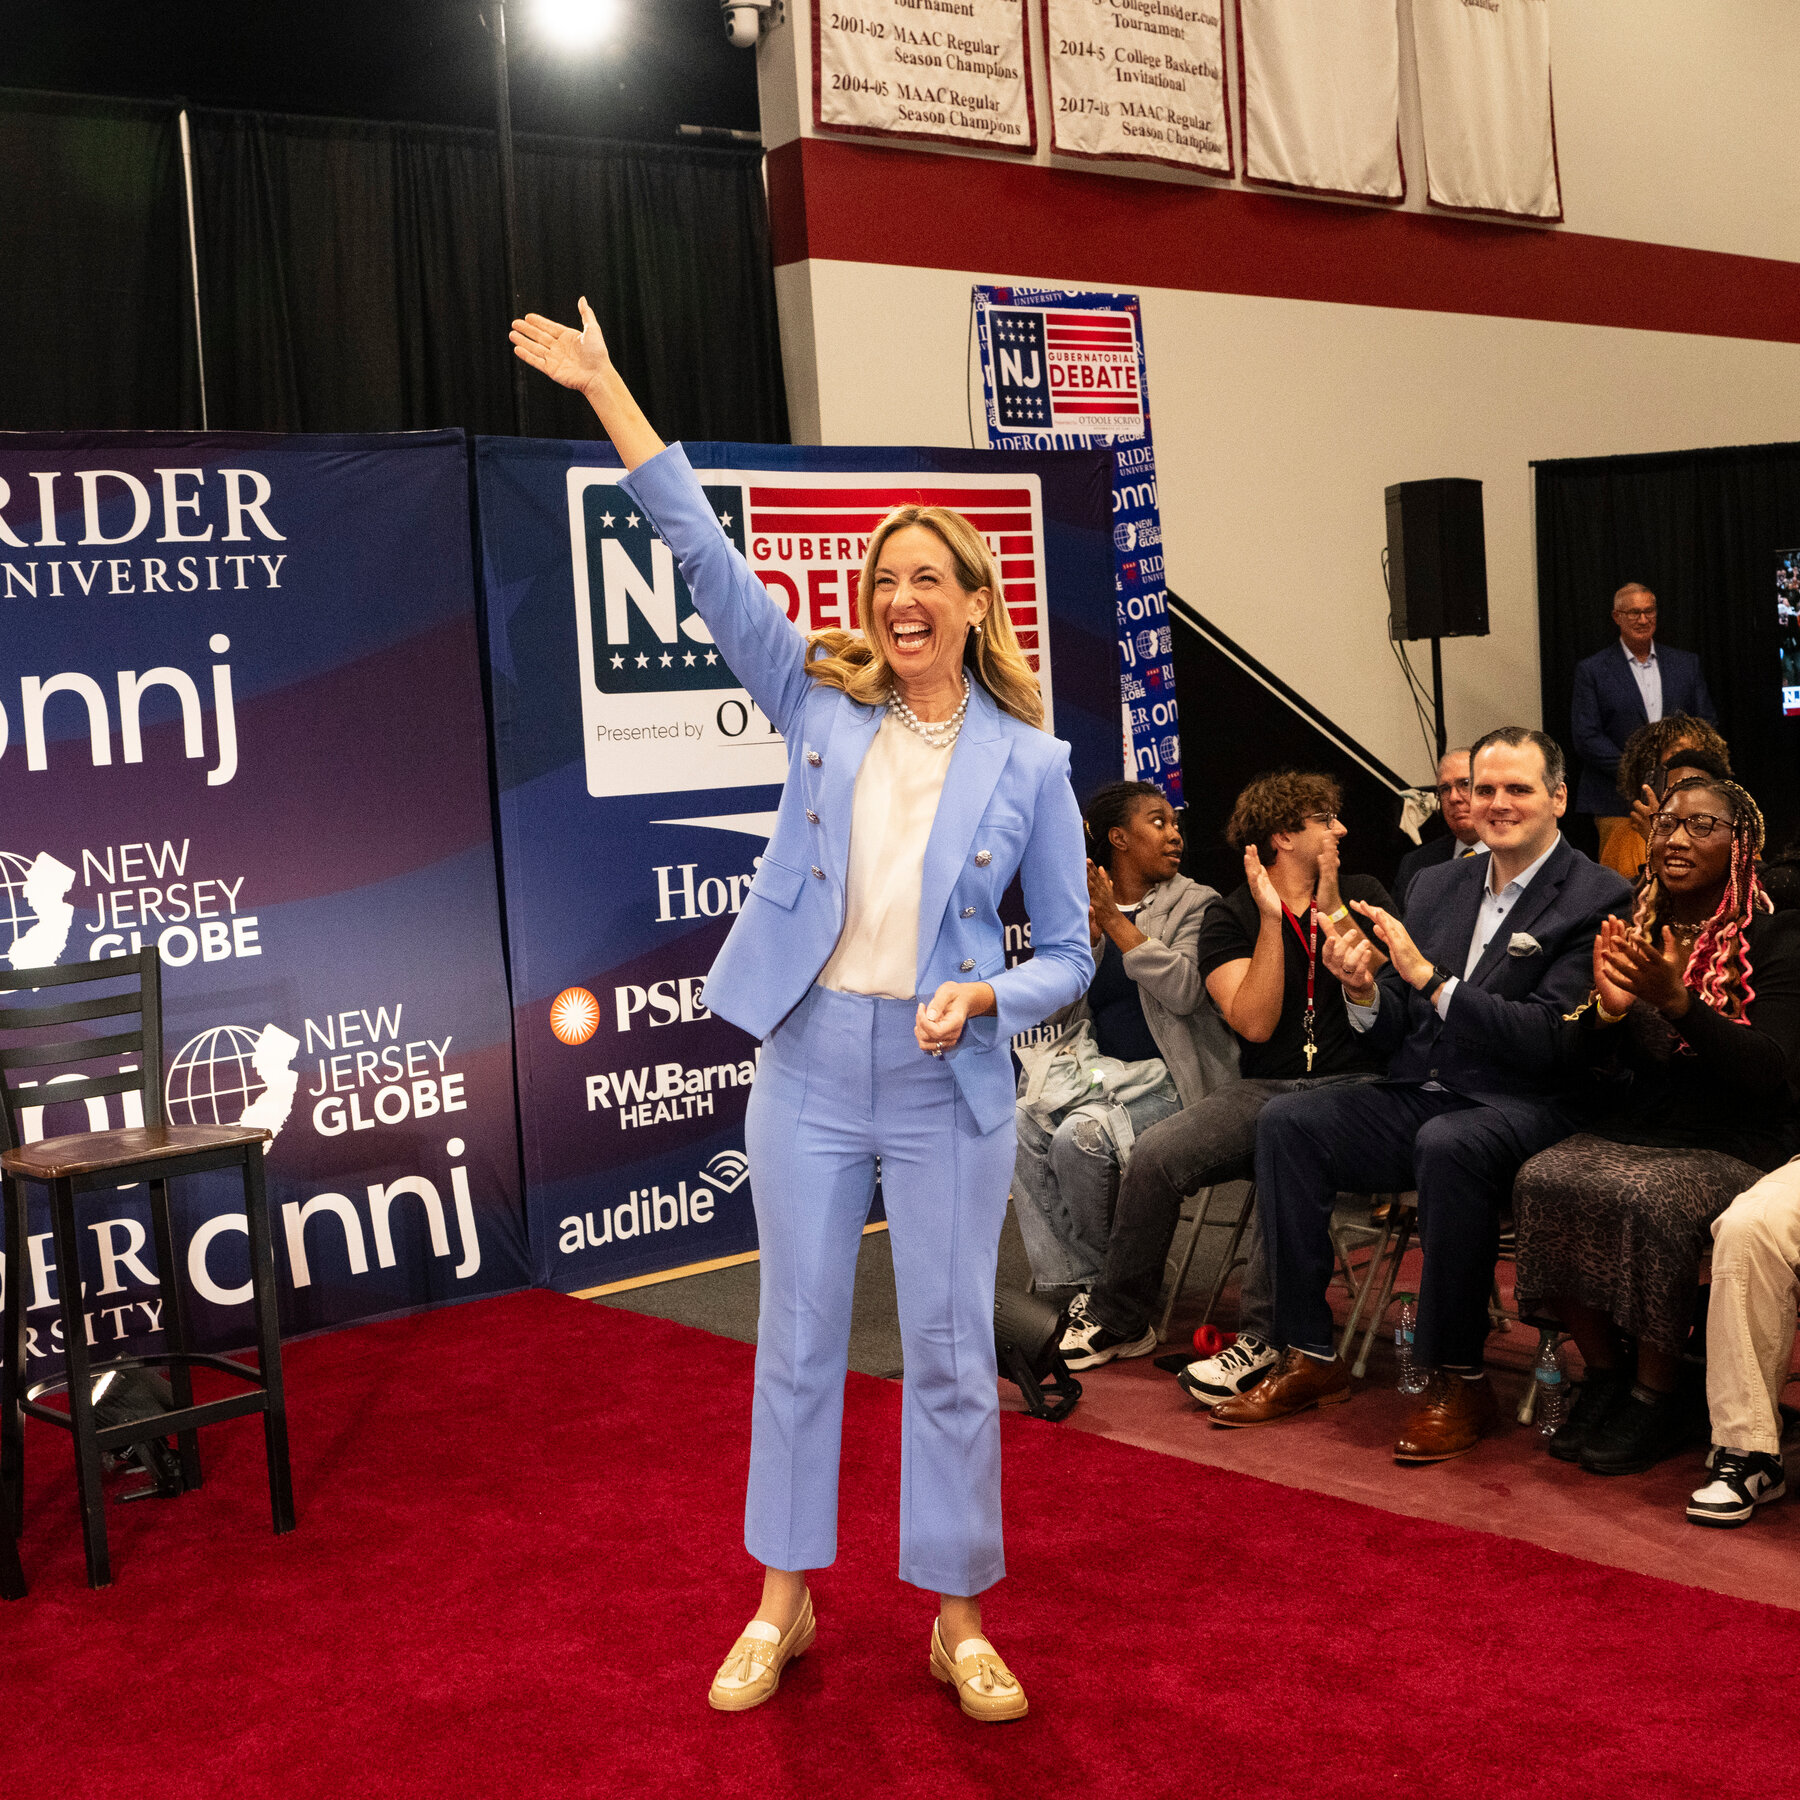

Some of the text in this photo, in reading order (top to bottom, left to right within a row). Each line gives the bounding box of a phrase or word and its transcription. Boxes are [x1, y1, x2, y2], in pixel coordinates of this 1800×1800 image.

[831, 13, 1000, 57] 2001-02 MAAC Regular
[1111, 13, 1185, 40] Tournament
[894, 46, 1018, 80] Season Champions
[1115, 47, 1161, 69] College
[831, 74, 1000, 112] 2004-05 MAAC Regular
[1115, 67, 1186, 92] Invitational
[898, 104, 1021, 136] Season Champions
[1120, 102, 1164, 122] MAAC
[1167, 109, 1212, 131] Regular
[1122, 121, 1163, 141] Season
[1013, 293, 1063, 306] UNIVERSITY
[1000, 348, 1041, 388] NJ
[1048, 352, 1135, 364] GUBERNATORIAL
[1049, 364, 1137, 389] DEBATE
[1079, 416, 1112, 425] O'TOOLE
[1113, 416, 1141, 425] SCRIVO
[0, 554, 287, 599] NIVERSITY
[597, 722, 679, 742] Presented
[684, 721, 704, 741] by
[82, 838, 190, 886] NEW
[85, 877, 245, 933] JERSEY
[304, 1004, 402, 1054] NEW
[309, 1036, 453, 1096] JERSEY
[586, 1047, 762, 1112] RWJBarna
[312, 1073, 467, 1137] GLOBE
[620, 1092, 714, 1130] HEALTH
[558, 1179, 715, 1254] audible
